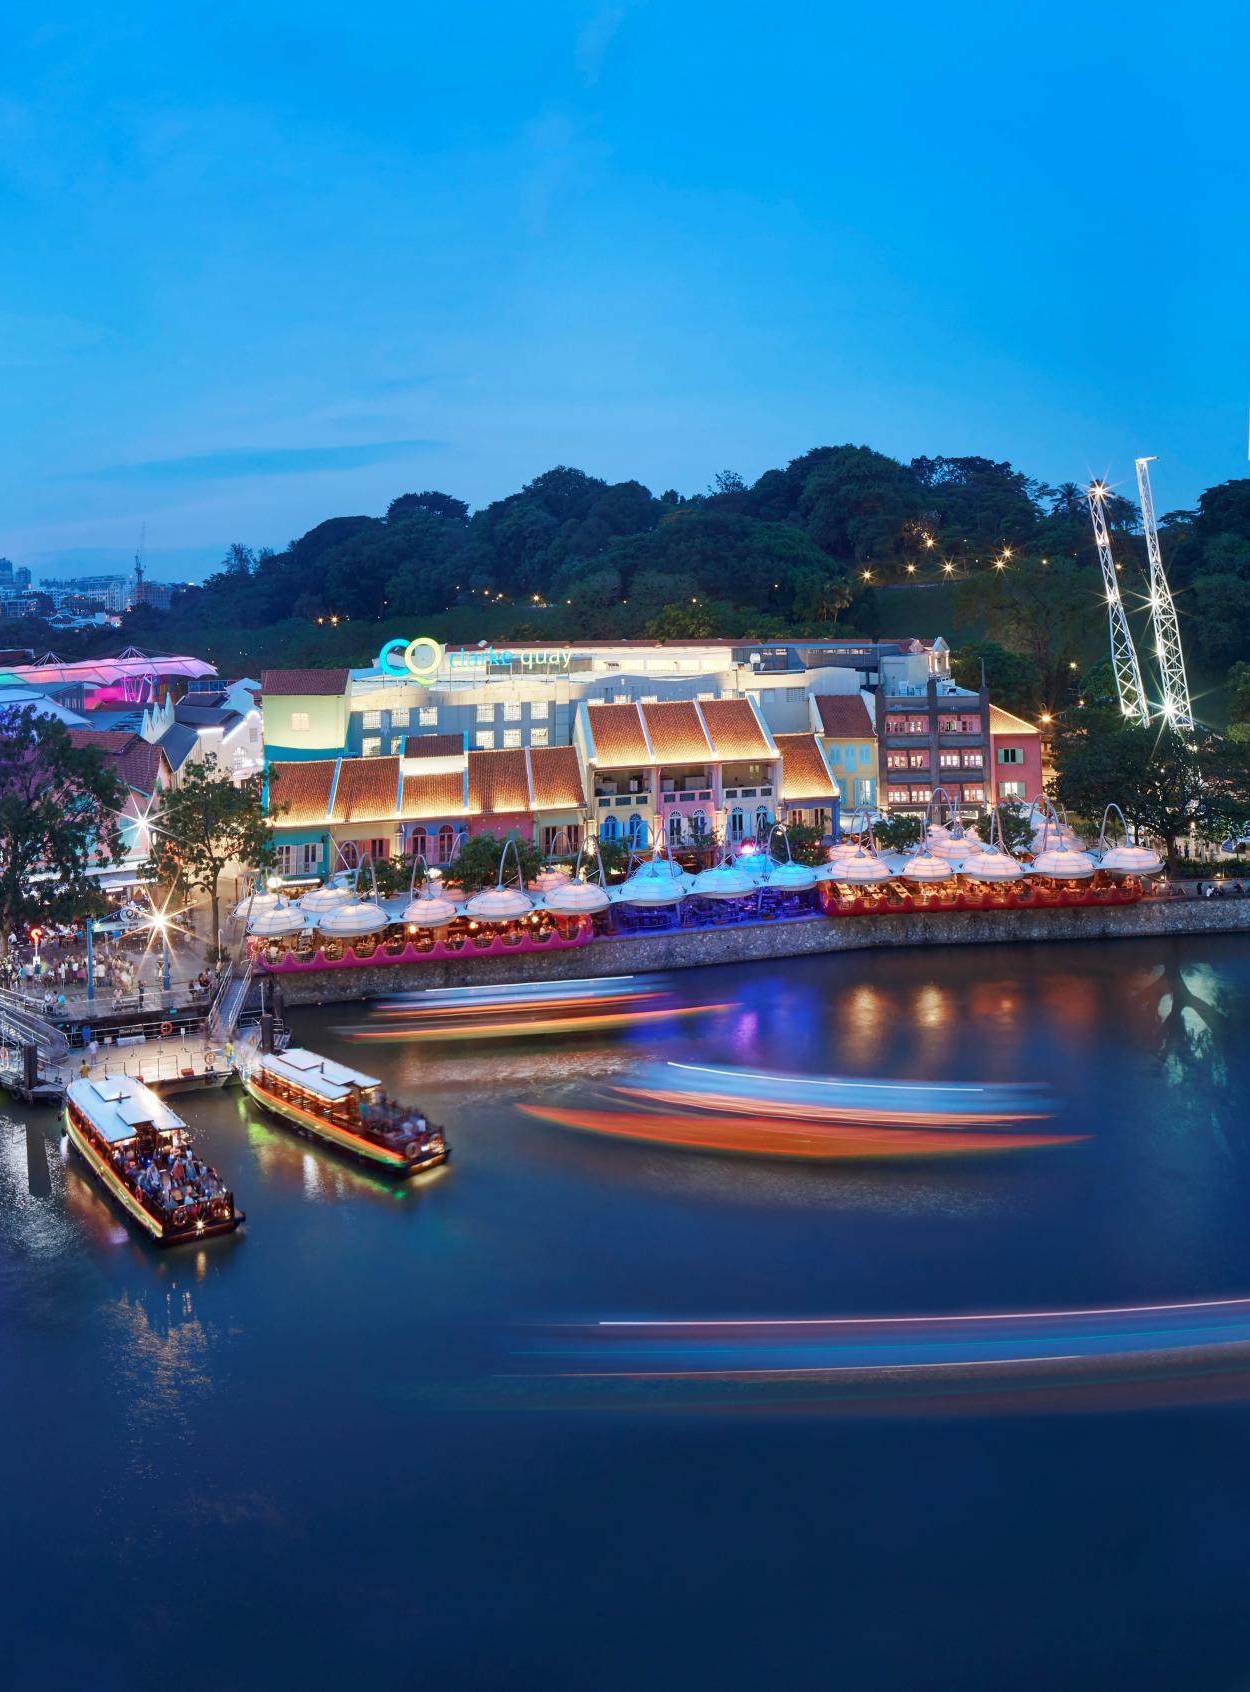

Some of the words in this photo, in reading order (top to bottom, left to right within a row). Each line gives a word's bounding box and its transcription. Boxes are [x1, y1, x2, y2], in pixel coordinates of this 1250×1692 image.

[379, 637, 442, 686] CQ
[449, 646, 513, 668] clarke
[520, 649, 572, 669] quay
